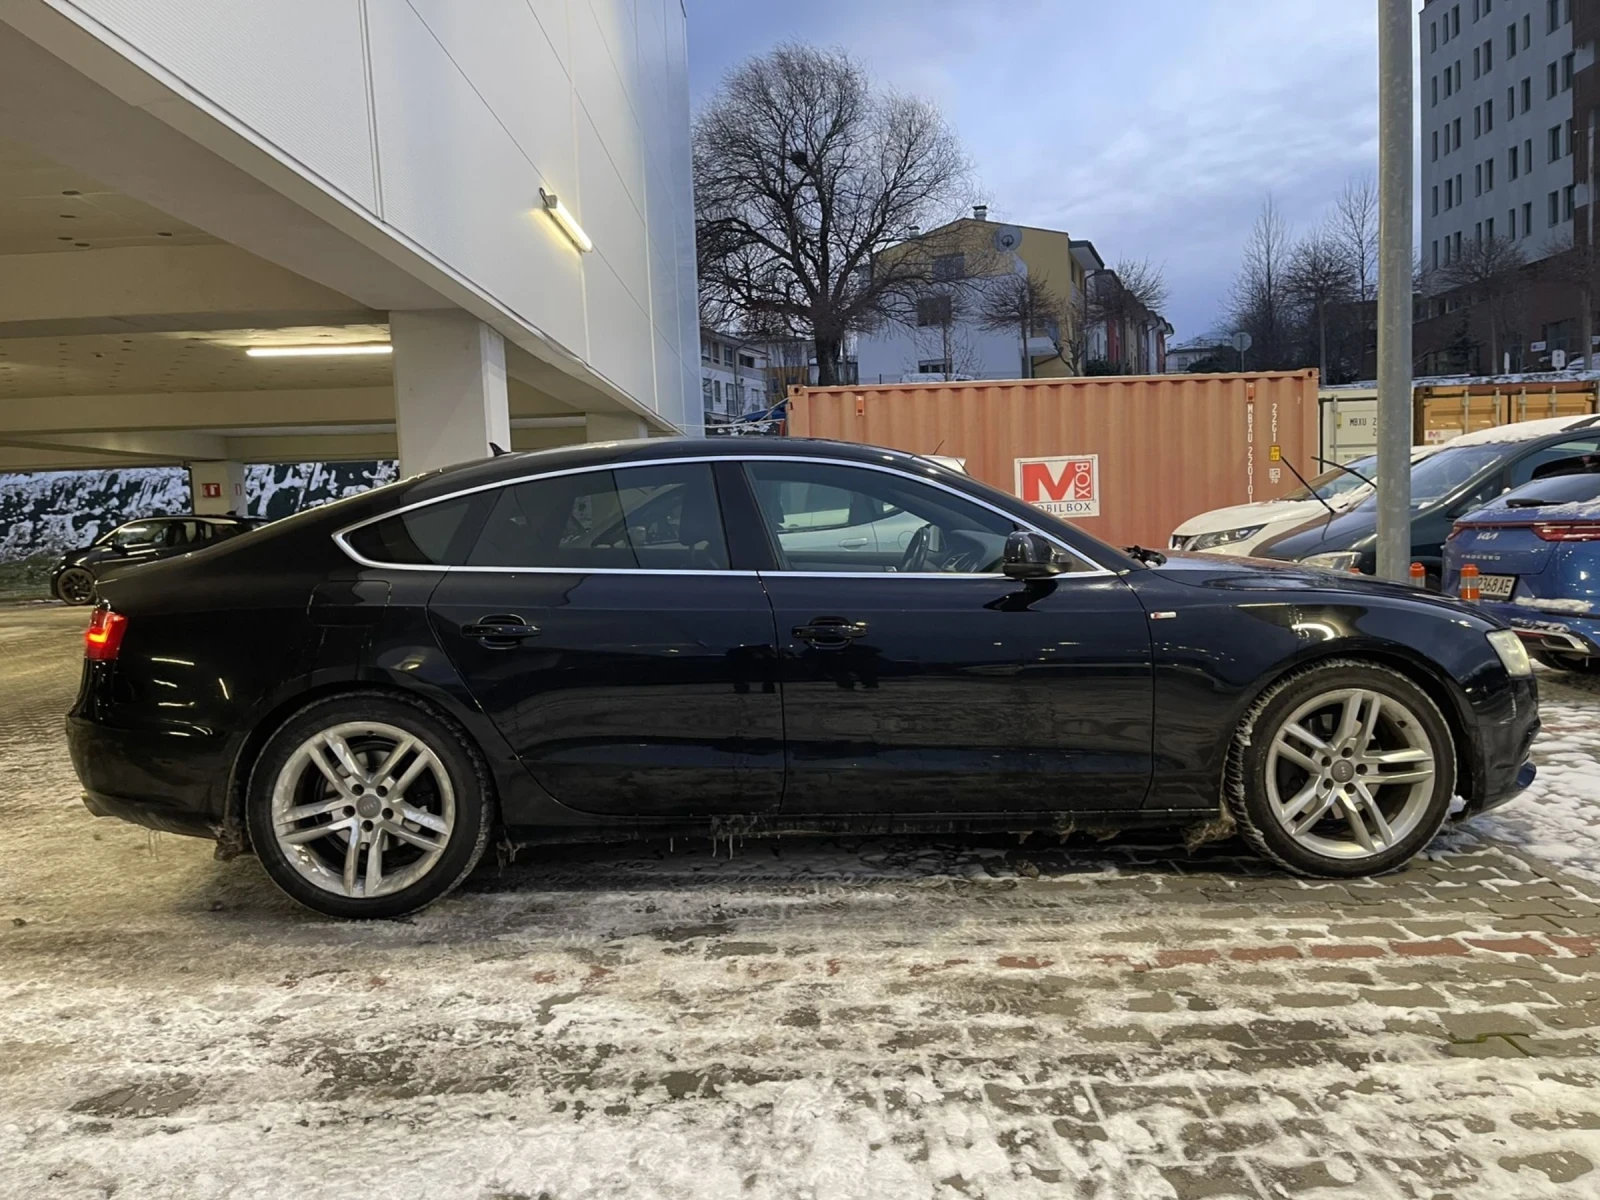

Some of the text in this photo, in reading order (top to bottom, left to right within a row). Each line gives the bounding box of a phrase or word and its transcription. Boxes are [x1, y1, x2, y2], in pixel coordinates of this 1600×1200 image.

[1023, 462, 1075, 502] M
[1075, 463, 1090, 498] BOX
[1036, 502, 1091, 513] OBILBOX
[1476, 532, 1498, 540] KIA
